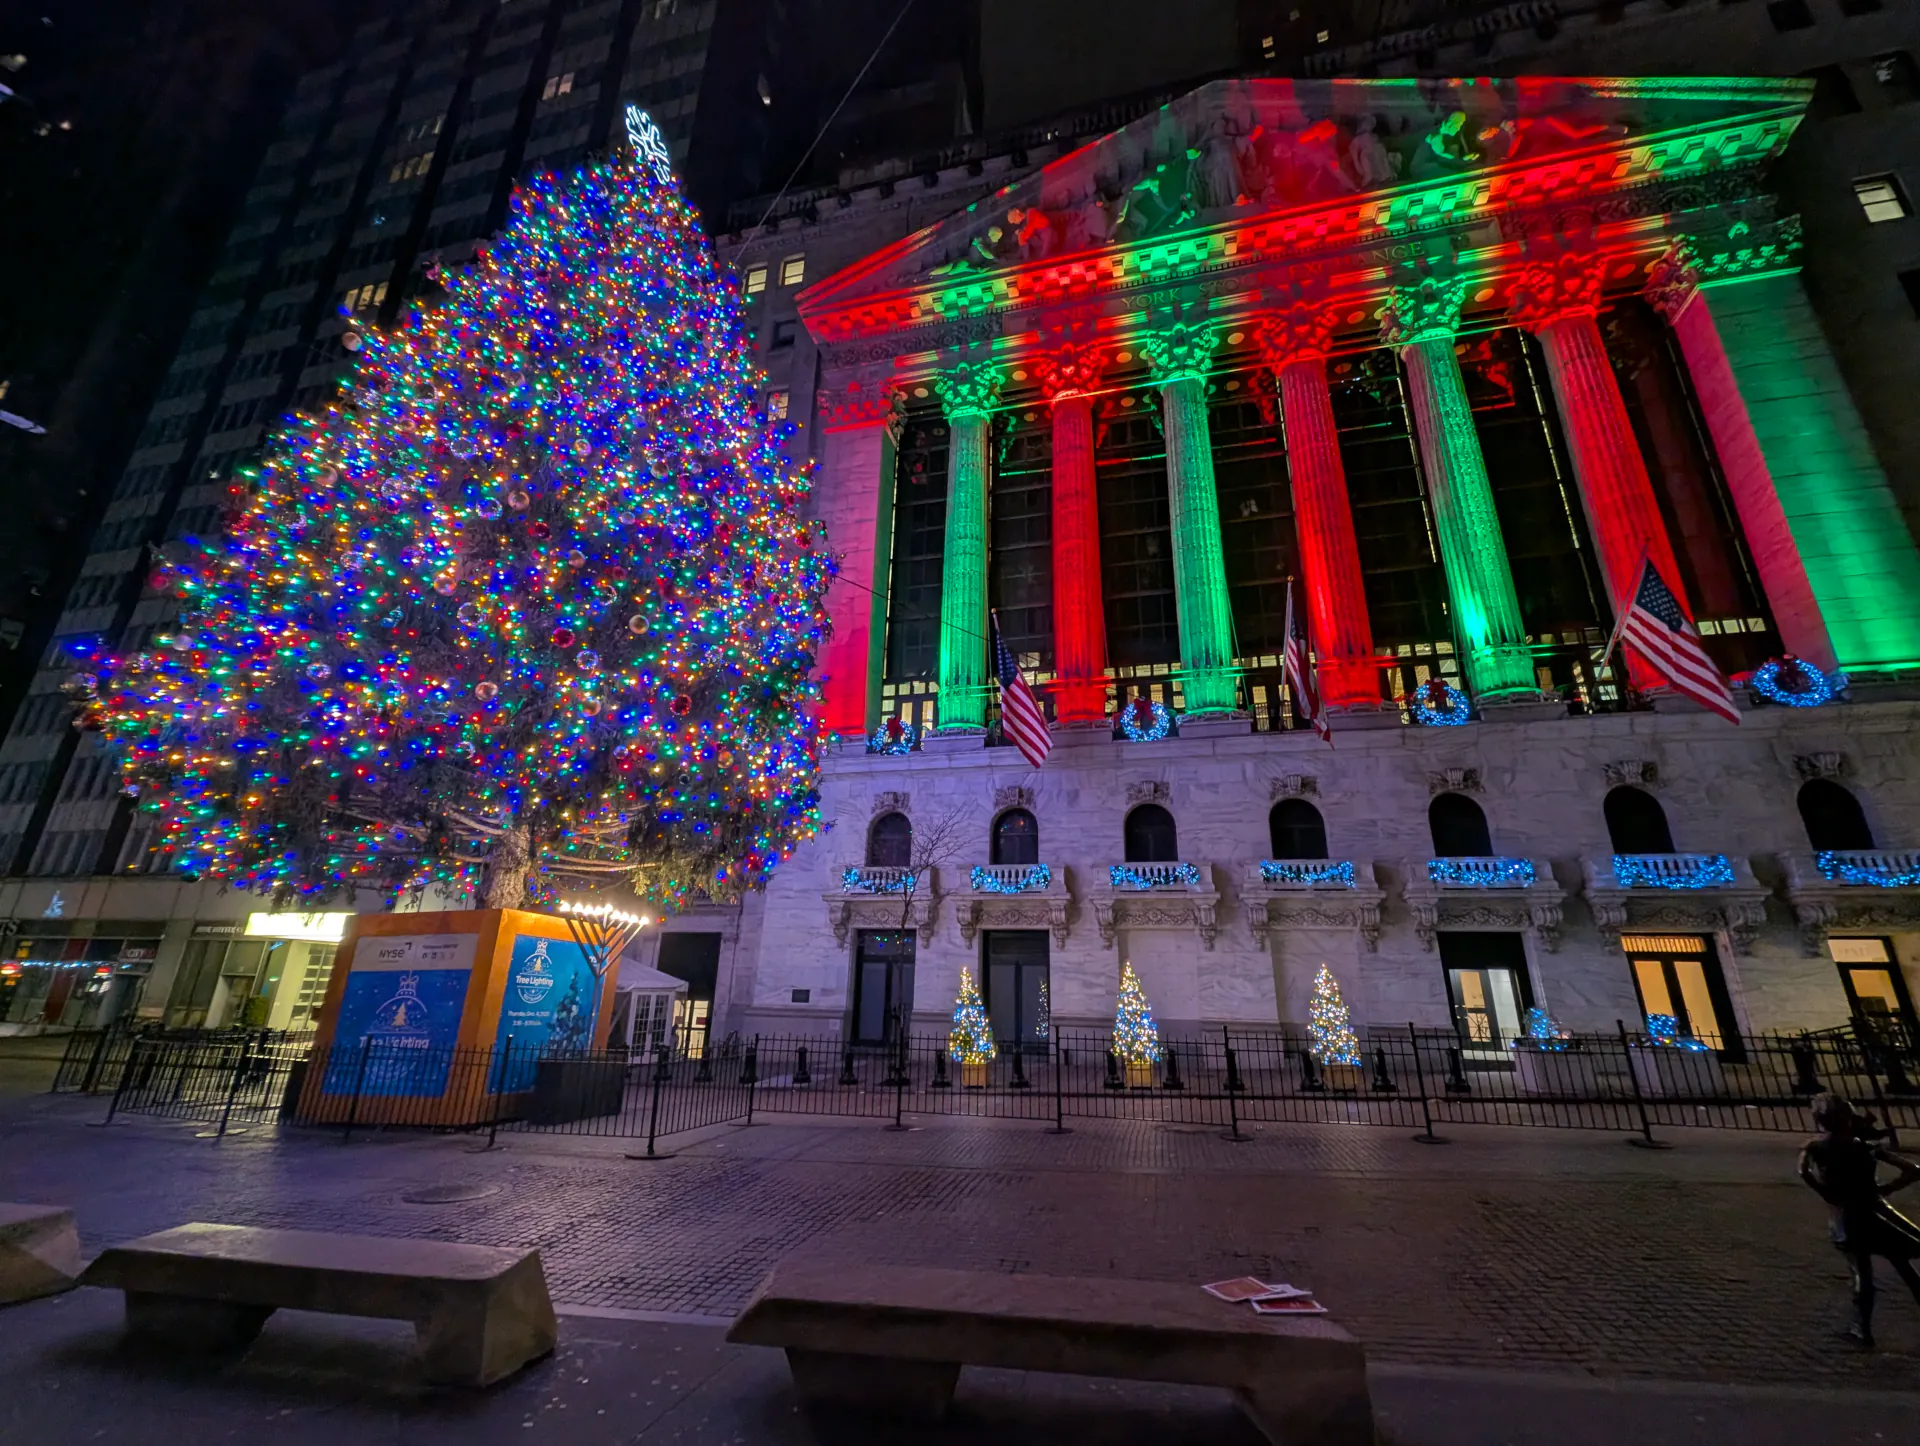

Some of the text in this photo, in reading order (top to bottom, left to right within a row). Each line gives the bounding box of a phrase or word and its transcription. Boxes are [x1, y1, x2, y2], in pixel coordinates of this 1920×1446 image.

[1120, 287, 1183, 310] YORK
[516, 975, 554, 988] Tree Lighting
[359, 1036, 383, 1050] Tee
